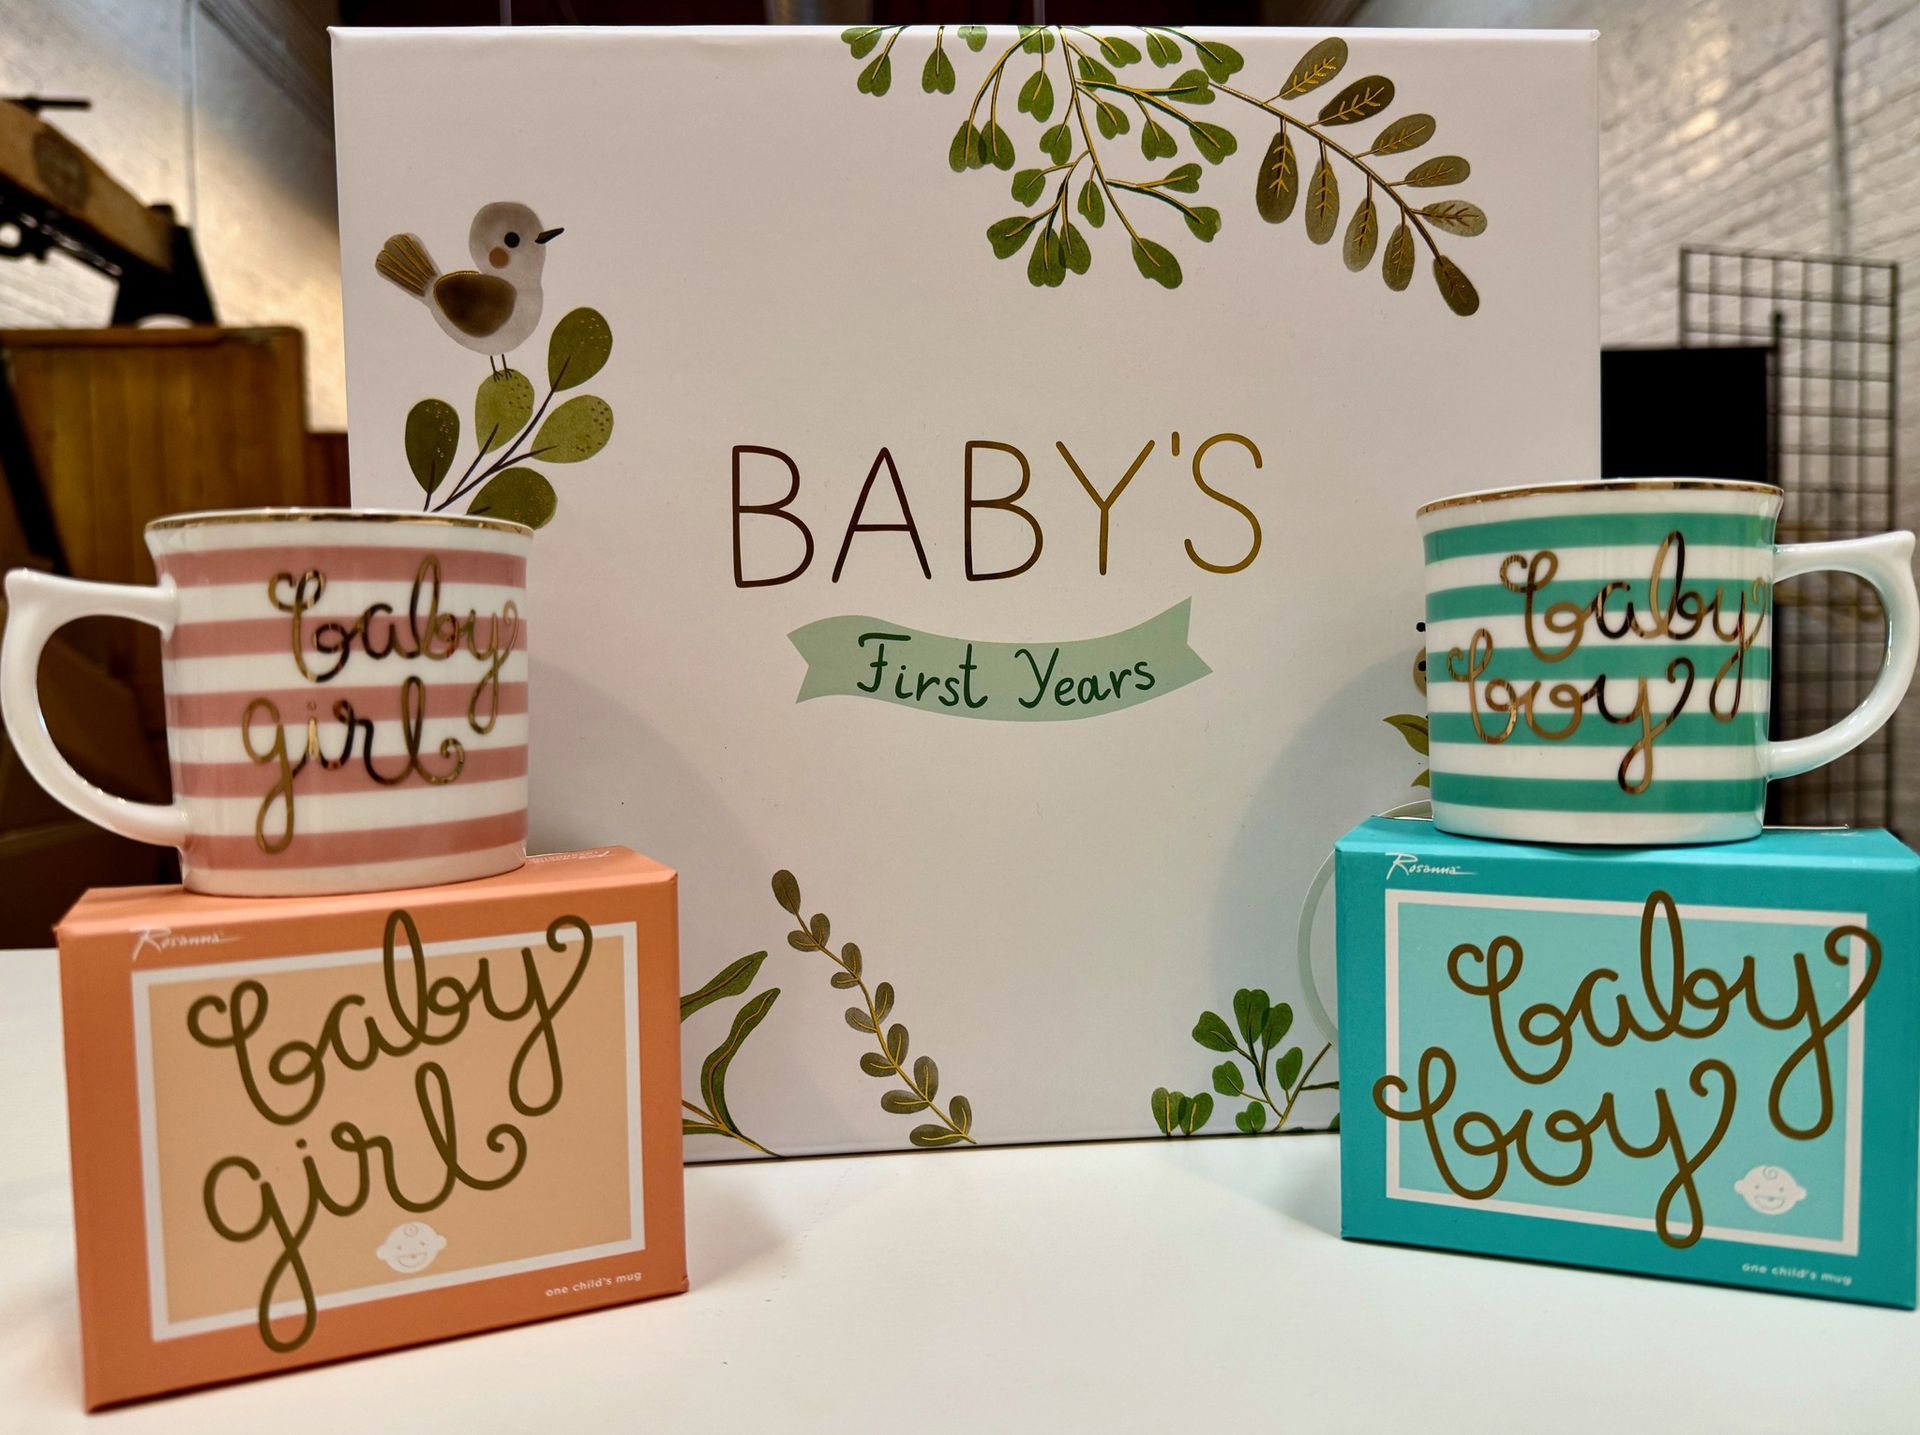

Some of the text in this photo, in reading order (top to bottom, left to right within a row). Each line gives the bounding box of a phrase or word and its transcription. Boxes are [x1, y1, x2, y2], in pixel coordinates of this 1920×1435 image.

[732, 431, 1263, 588] BABY'S
[268, 555, 518, 734] baby
[857, 632, 1156, 709] First Years
[1447, 629, 1695, 794] boy
[1500, 531, 1768, 722] baby
[242, 676, 465, 854] girl
[187, 909, 593, 1125] baby
[1447, 890, 1882, 1141] baby
[203, 1061, 527, 1353] girl
[1372, 1046, 1737, 1249] boy
[545, 1271, 642, 1298] one child's mug
[1742, 1263, 1852, 1287] one child's mug
